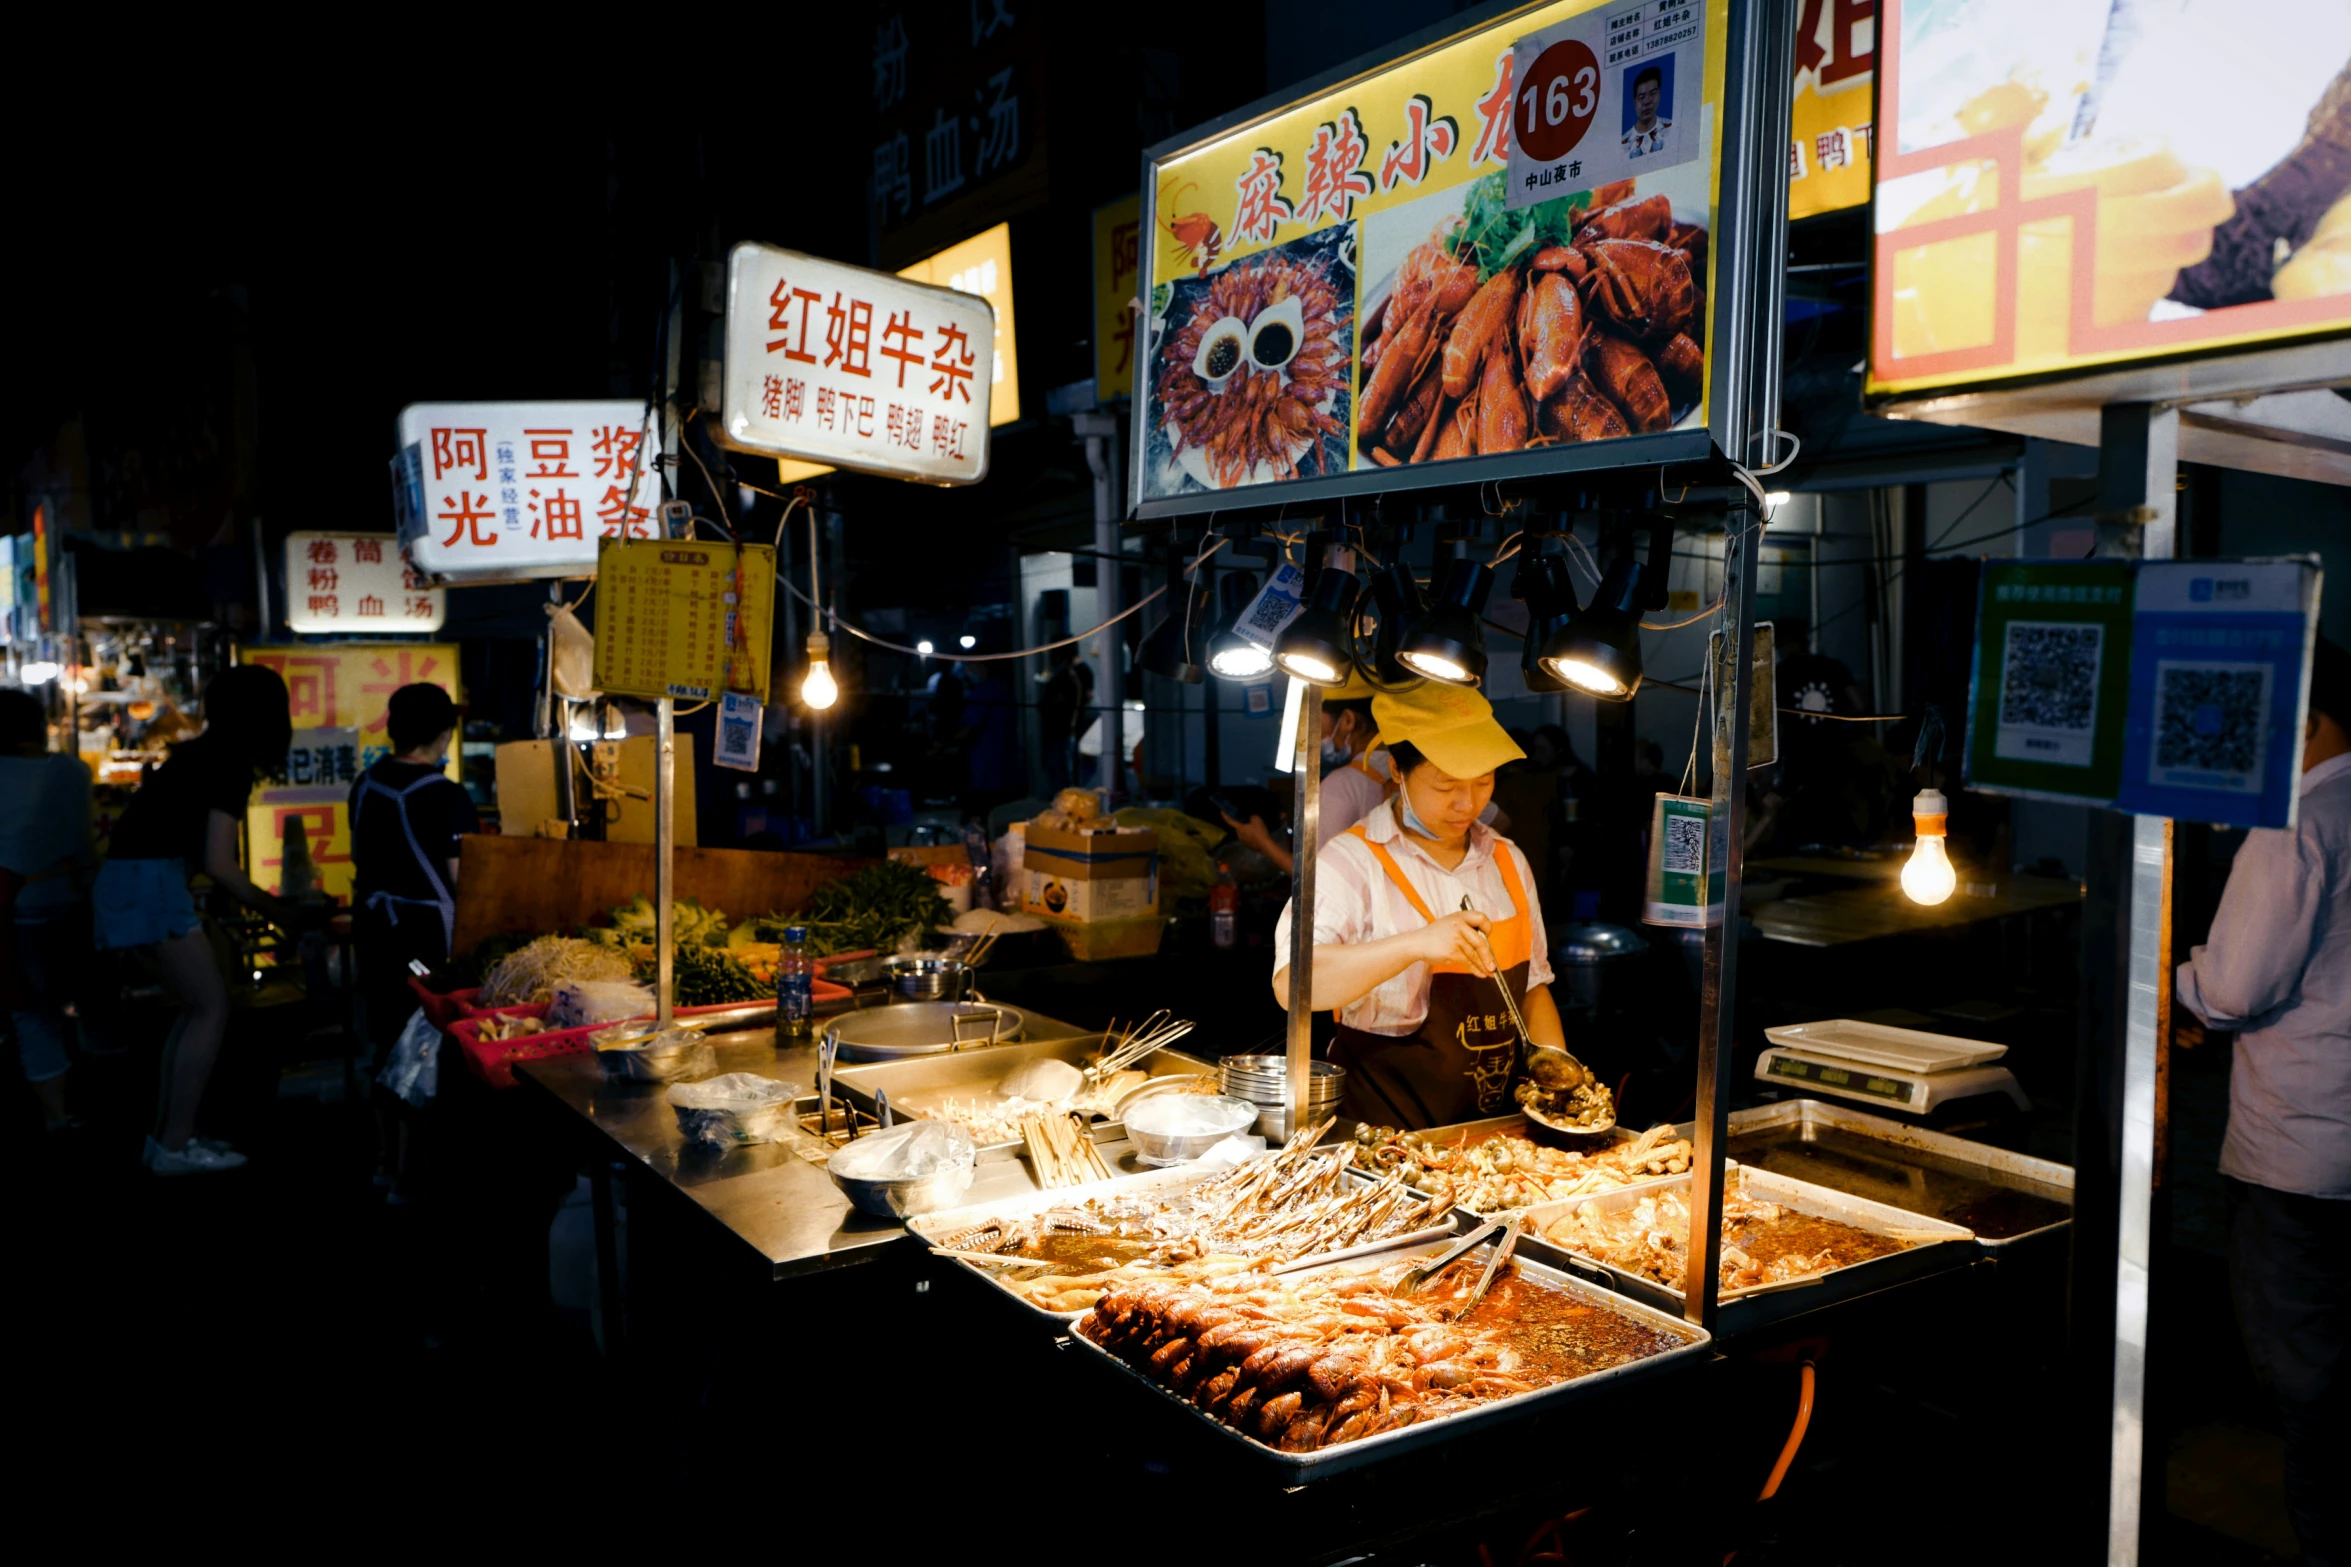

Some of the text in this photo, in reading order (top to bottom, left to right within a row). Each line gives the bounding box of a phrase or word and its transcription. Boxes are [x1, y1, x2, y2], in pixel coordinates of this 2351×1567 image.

[1608, 26, 1697, 64] 联系电话 13878820257
[1609, 9, 1690, 46] 店铺名称 红姐牛杂
[1522, 66, 1597, 134] 163
[872, 63, 1021, 228] 鸭血汤
[1525, 160, 1583, 191] 中山夜市
[766, 277, 976, 404] 红姐牛杂
[762, 373, 806, 424] 猪脚
[817, 386, 876, 438] 鸭下巴
[932, 413, 968, 461] 鸭红
[523, 425, 646, 480] 豆浆
[430, 427, 498, 548] 阿光
[527, 484, 651, 542] 油条
[307, 539, 413, 565] 卷筒
[308, 594, 433, 618] 鸭血汤
